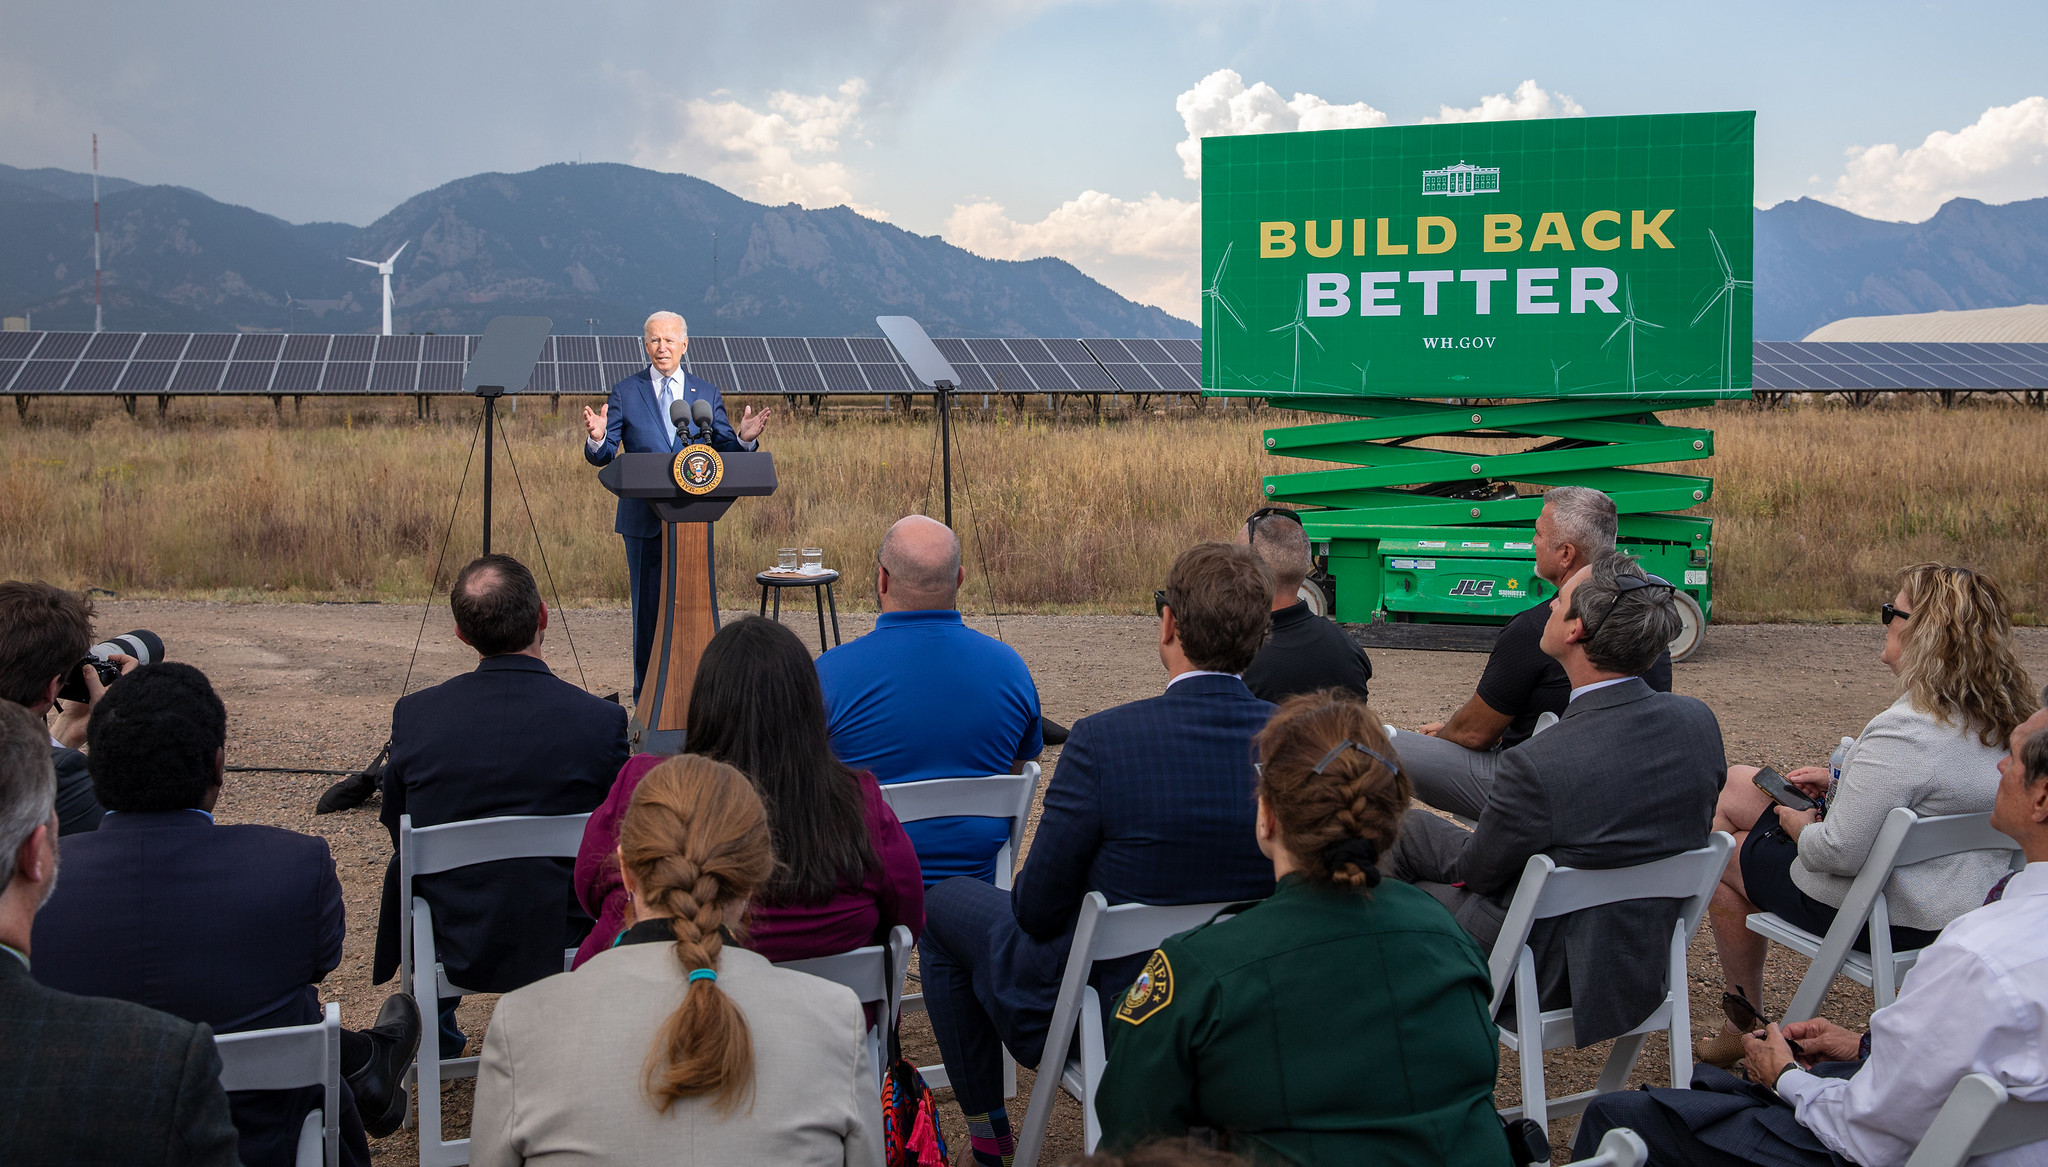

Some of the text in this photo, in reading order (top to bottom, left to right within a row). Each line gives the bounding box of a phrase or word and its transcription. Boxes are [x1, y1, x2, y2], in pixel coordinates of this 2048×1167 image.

[1260, 209, 1676, 259] BUILD BACK
[1306, 267, 1621, 317] BETTER
[1422, 336, 1497, 349] WH.GOV
[676, 446, 697, 469] PRESIDENT
[711, 451, 722, 472] UNITED
[703, 476, 720, 492] STATES
[1449, 579, 1496, 597] JLG
